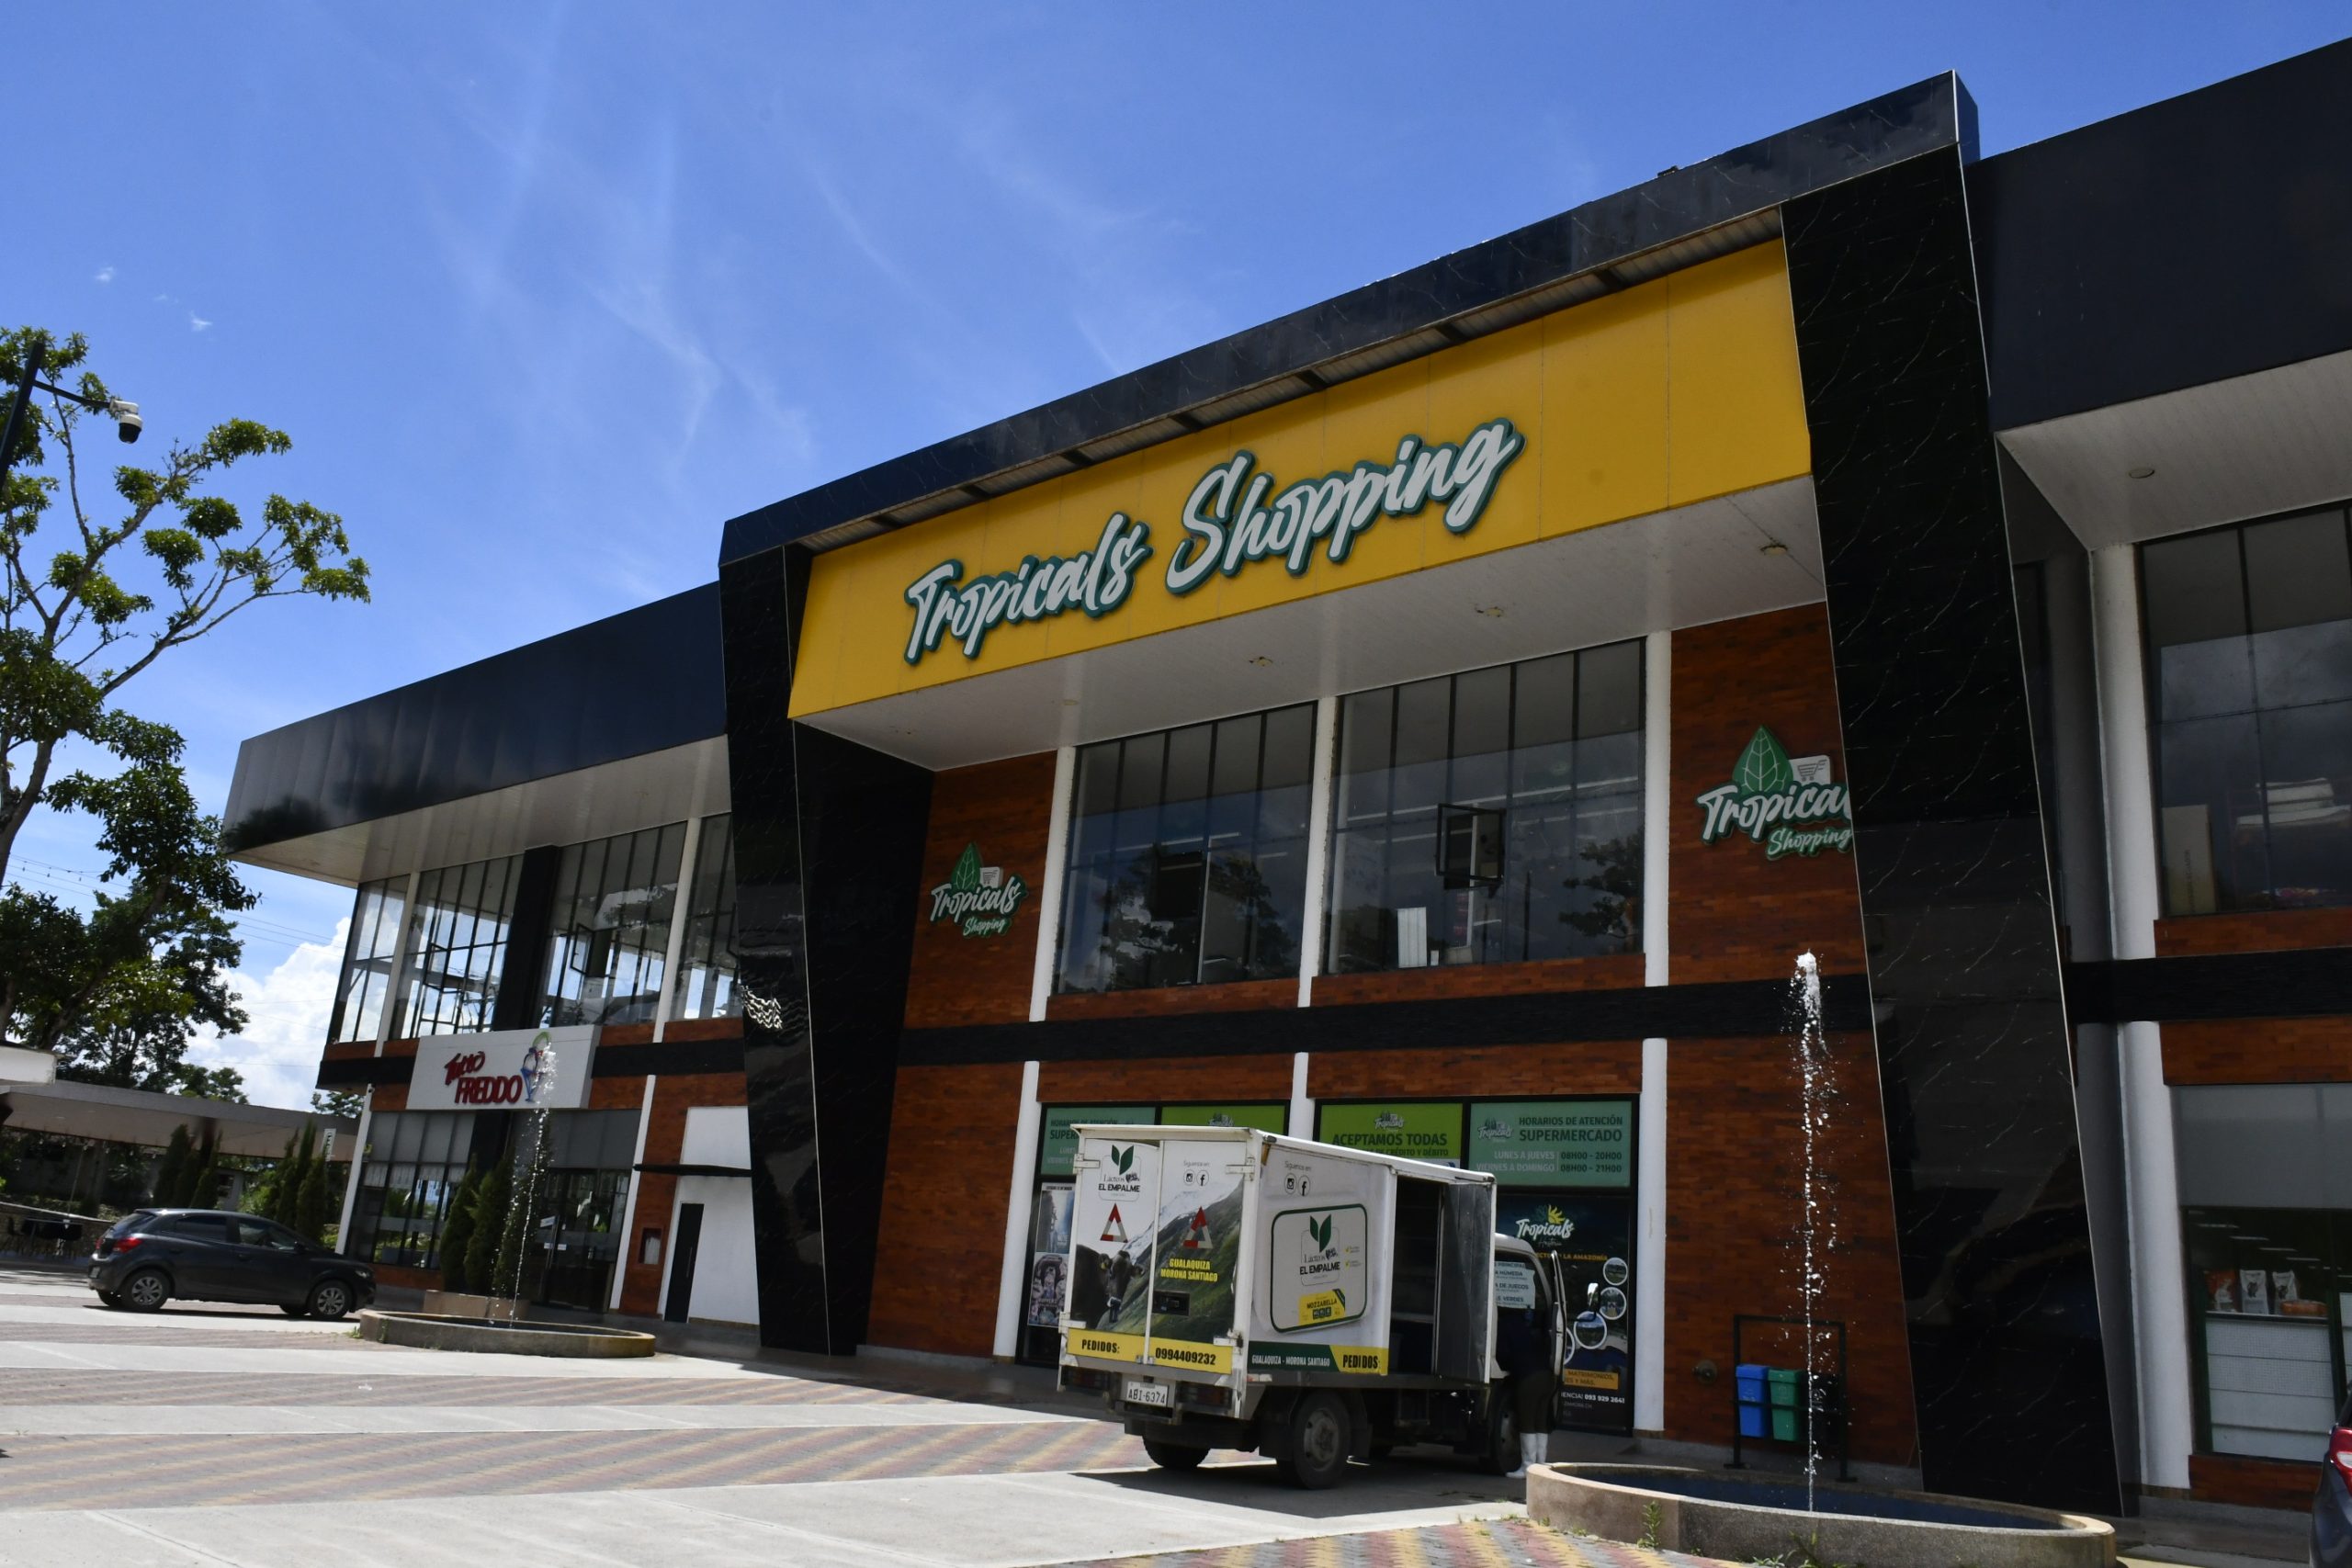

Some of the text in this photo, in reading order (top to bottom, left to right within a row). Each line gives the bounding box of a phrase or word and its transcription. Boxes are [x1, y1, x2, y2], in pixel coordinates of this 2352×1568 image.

[905, 418, 1525, 665] Tropicals Shopping
[1767, 828, 1852, 855] Shopping
[930, 875, 1023, 923] Tropicals
[963, 917, 1008, 936] Shopping
[455, 1075, 523, 1105] FREDDO
[1519, 1114, 1623, 1125] HORARIOS DE ATENCIÓN
[1333, 1133, 1447, 1145] ACEPTAMOS TODAS
[1520, 1129, 1622, 1142] SUPERMERCADO
[1494, 1151, 1519, 1159] LUNES
[1528, 1151, 1555, 1160] JUEVES
[1560, 1152, 1587, 1160] 08H00
[1595, 1152, 1623, 1160] 20H00
[1476, 1163, 1508, 1171] VIERNES
[1517, 1163, 1555, 1171] DOMINGO
[1107, 1184, 1140, 1192] EMPALME
[1516, 1218, 1575, 1240] Tropicals
[1170, 1258, 1210, 1270] GUALAQUIZA
[1300, 1267, 1308, 1275] EL
[1309, 1262, 1340, 1274] EMPALME
[1160, 1269, 1217, 1282] MORONA SANTIAGO
[1081, 1339, 1120, 1354] PEDIDOS:
[1155, 1348, 1216, 1365] 0994409232
[1251, 1355, 1281, 1365] GUALAQUIZA
[1285, 1356, 1306, 1366] MORONA
[1307, 1357, 1330, 1367] SANTIAGO
